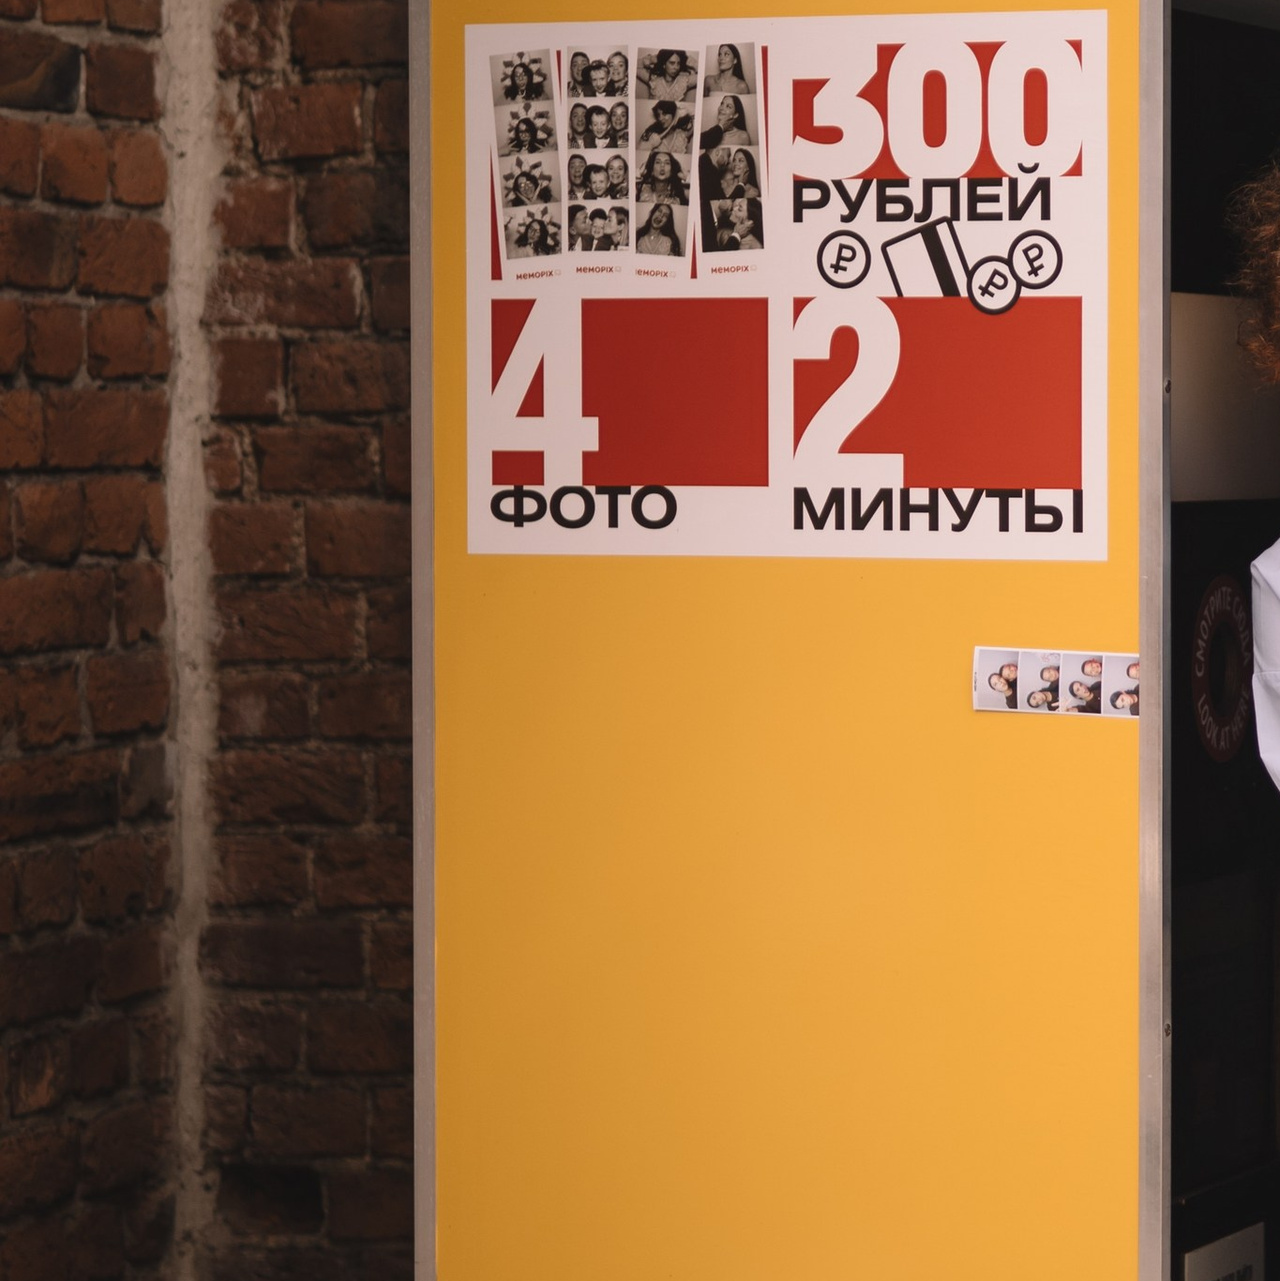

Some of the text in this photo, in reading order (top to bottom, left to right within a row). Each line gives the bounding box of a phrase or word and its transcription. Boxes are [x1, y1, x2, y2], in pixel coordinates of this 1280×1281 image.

[792, 39, 1084, 179] 300
[792, 162, 1051, 223] РУБЛЕЙ
[490, 298, 600, 487] 4
[792, 296, 905, 488] 2
[490, 484, 678, 530] ФОТО
[792, 487, 1084, 534] МИНУТЫ
[1194, 585, 1233, 678] СМОТРИТЕ
[1197, 682, 1250, 752] LOOK AT HERE
